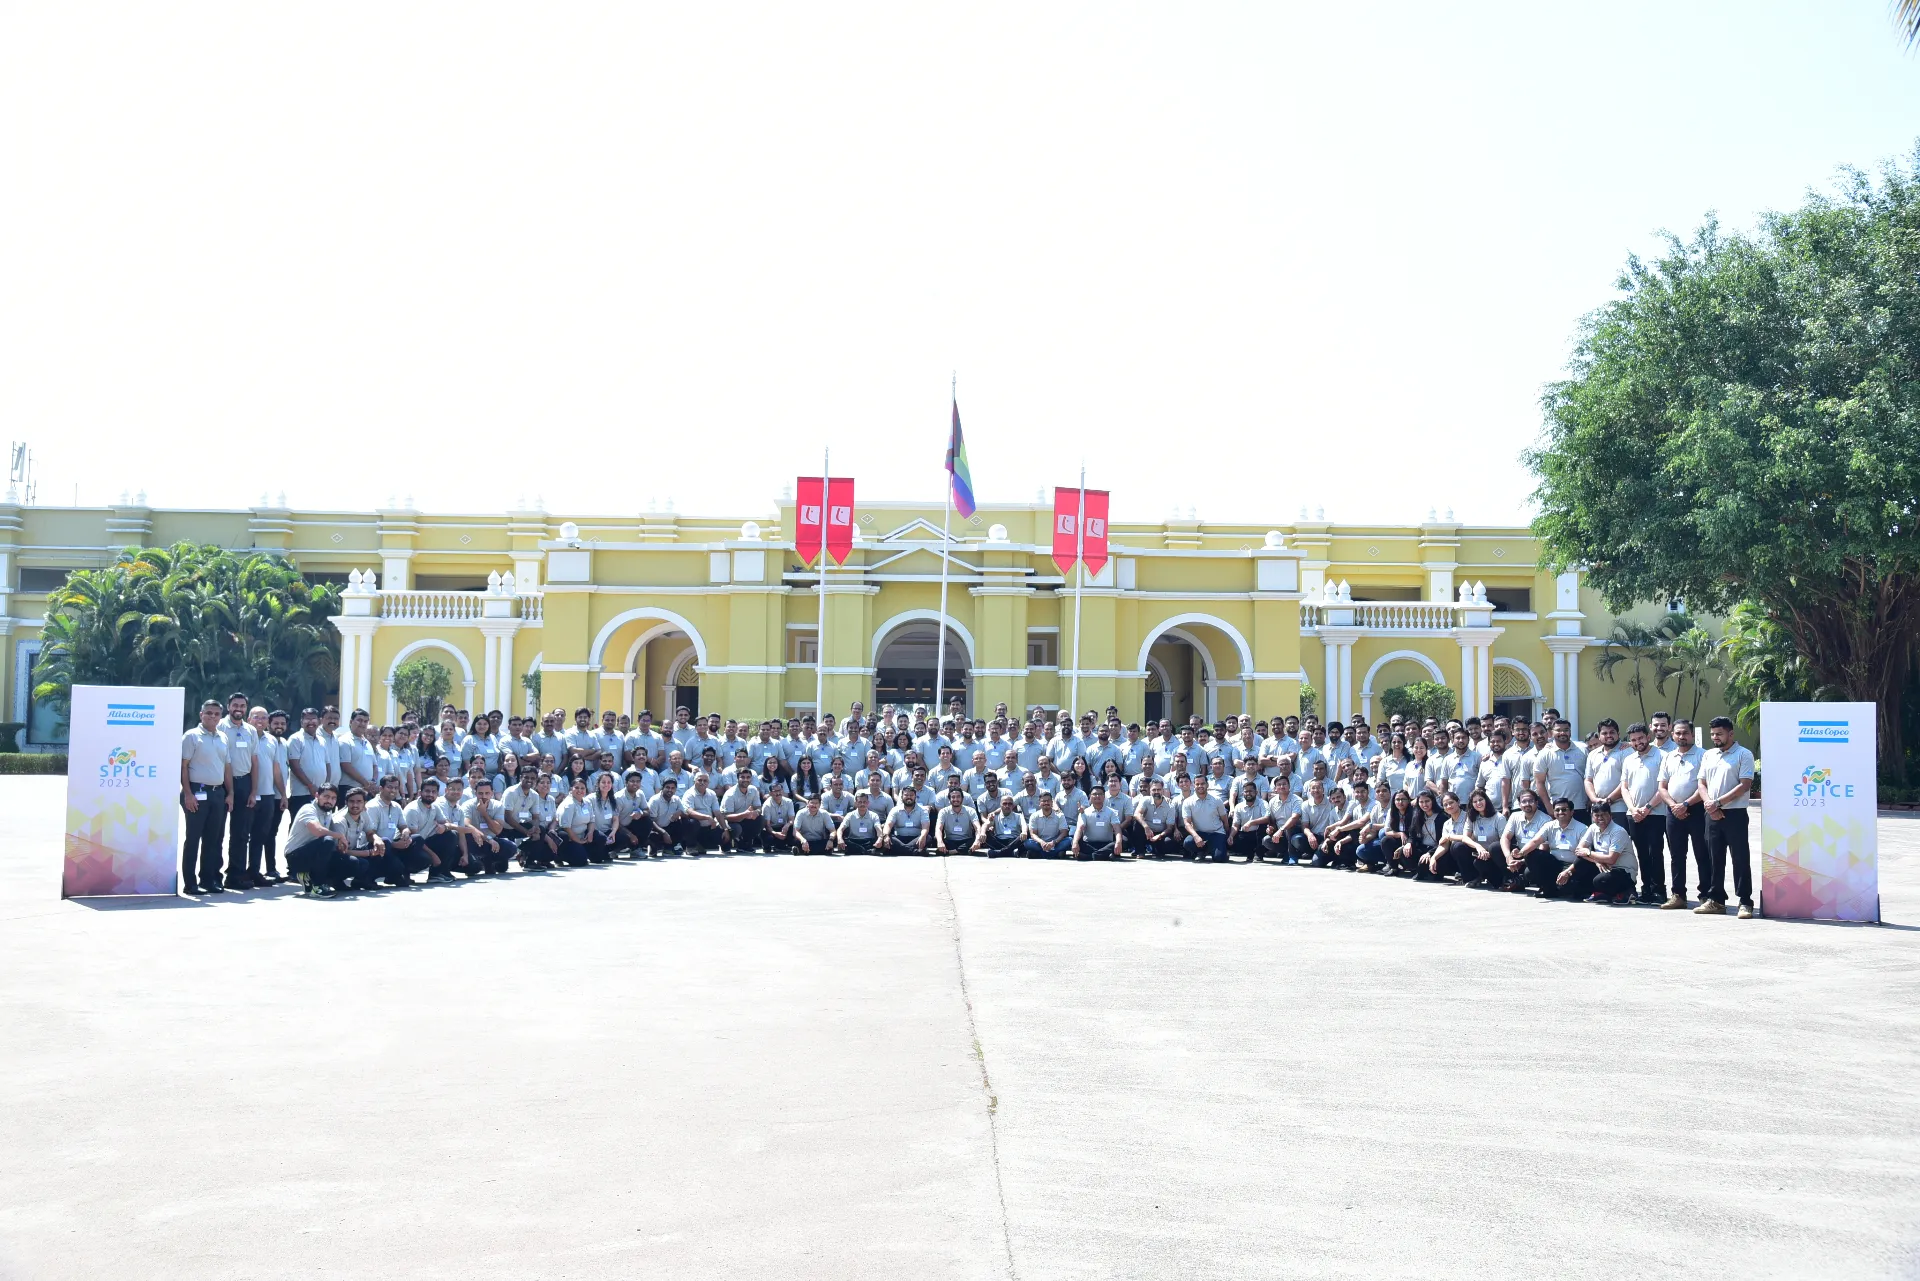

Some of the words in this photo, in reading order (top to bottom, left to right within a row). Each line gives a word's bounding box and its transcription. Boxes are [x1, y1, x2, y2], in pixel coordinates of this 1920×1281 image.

[107, 710, 131, 718] Atlas
[132, 711, 155, 720] Copco
[1799, 727, 1823, 735] Atlas
[1824, 727, 1849, 737] Copco
[100, 765, 157, 778] SPICE
[99, 778, 130, 788] 2023
[1794, 783, 1854, 798] SPICE
[1793, 797, 1826, 807] 2023
